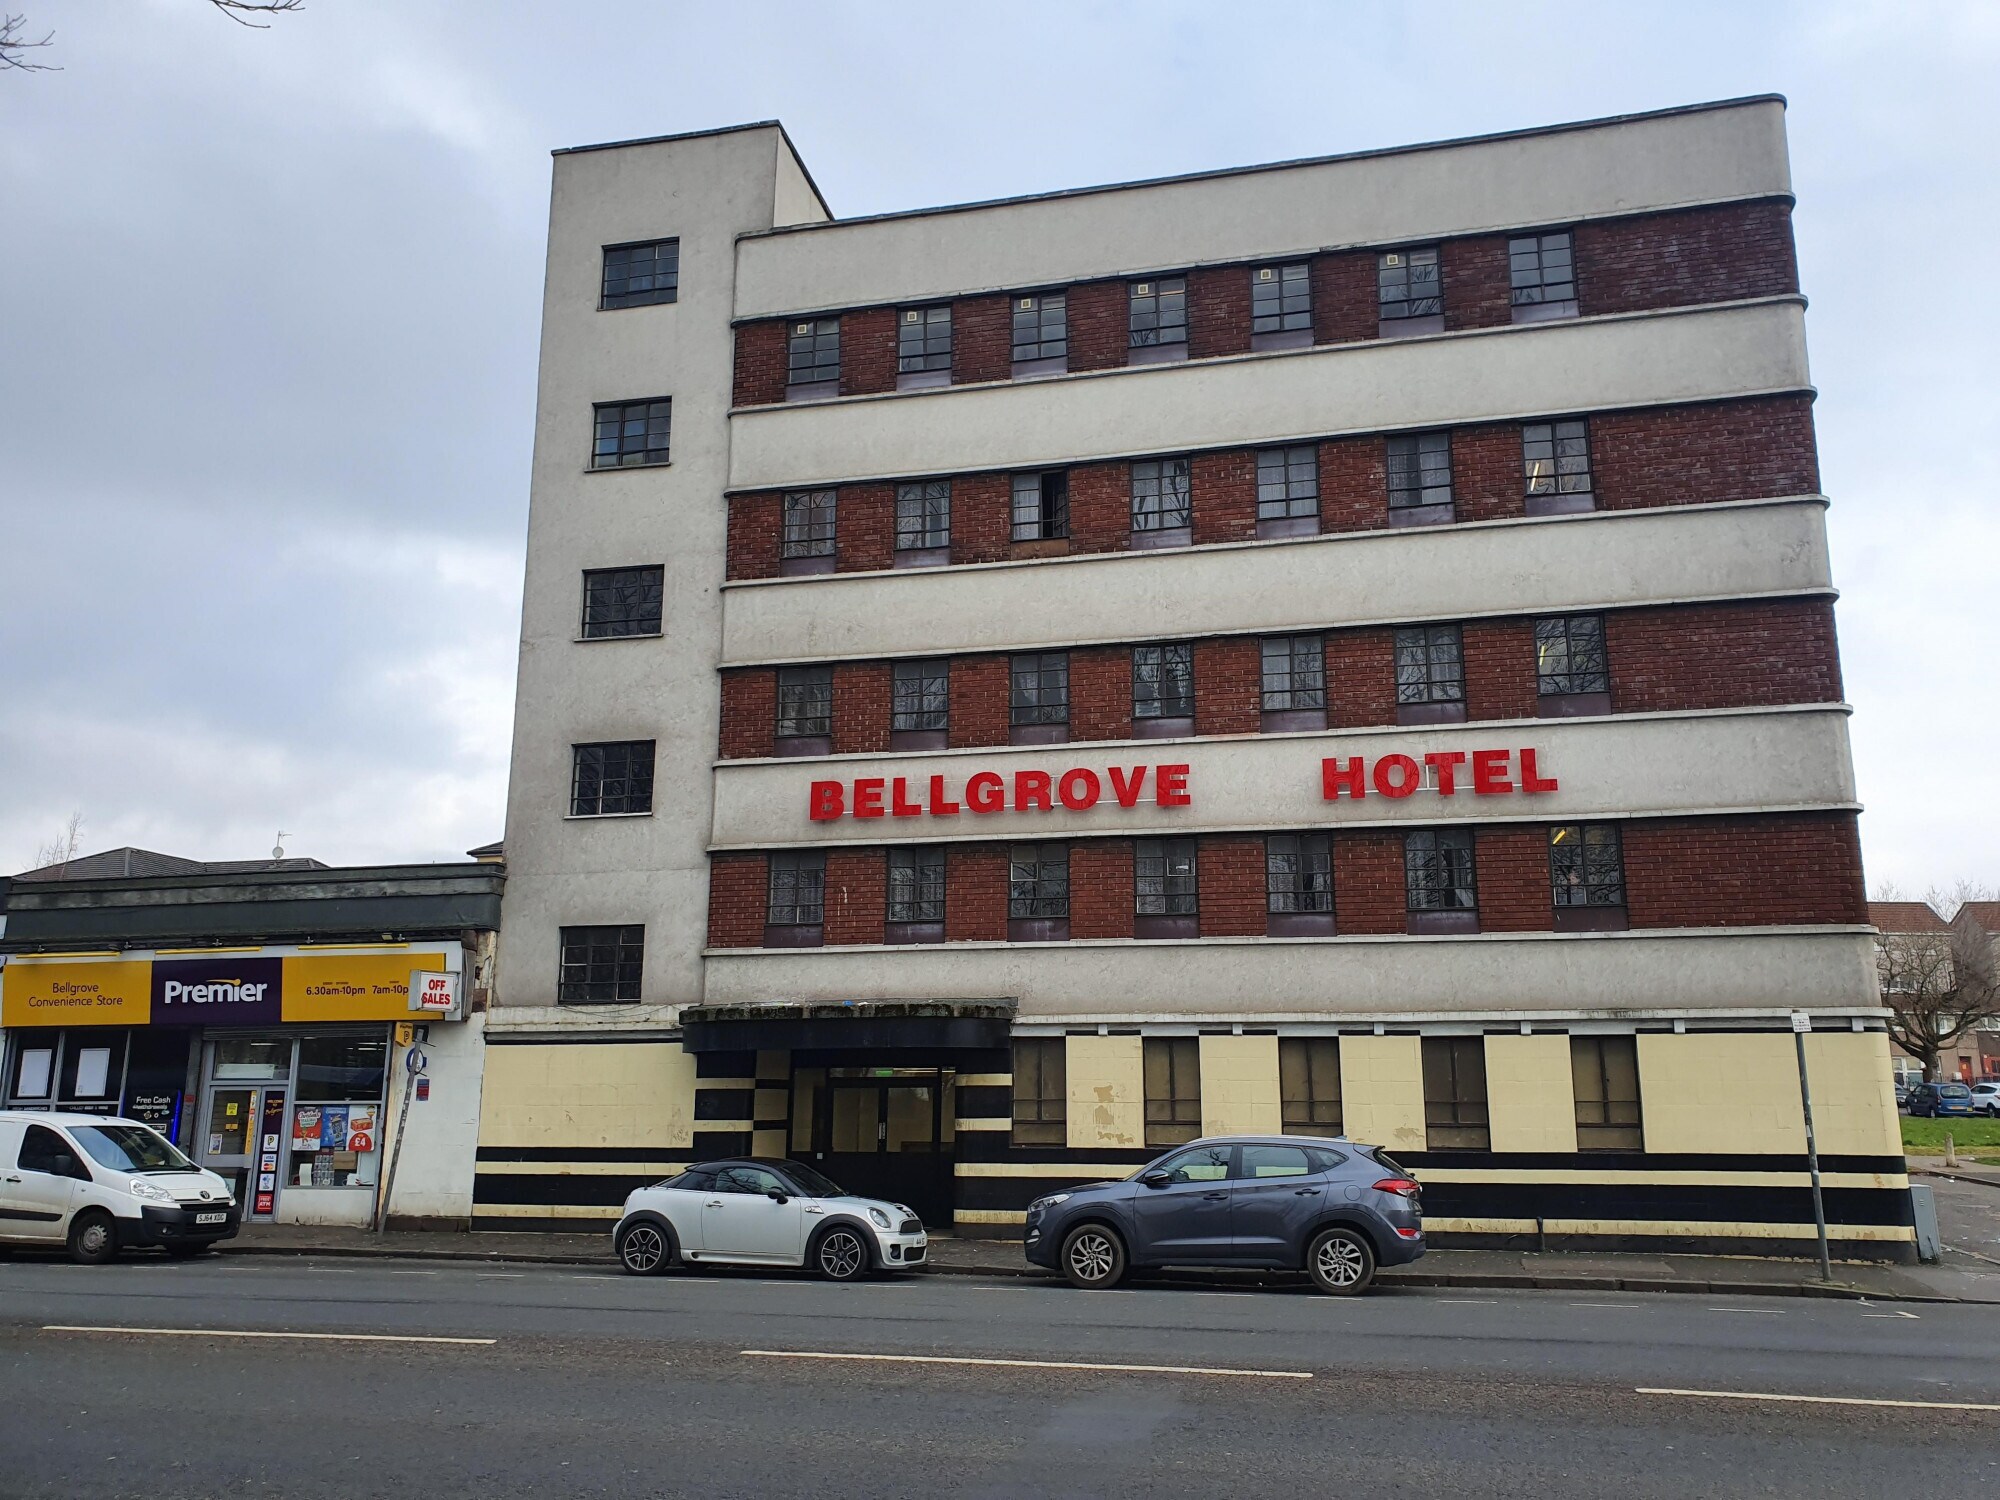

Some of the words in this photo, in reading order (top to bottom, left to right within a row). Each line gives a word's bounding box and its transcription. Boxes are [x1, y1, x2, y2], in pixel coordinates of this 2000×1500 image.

[809, 764, 1191, 821] BELLGROVE
[1321, 748, 1559, 801] HOTEL
[52, 982, 99, 996] Bellgrove
[306, 985, 366, 996] 6.30am-10pm
[372, 984, 409, 996] 7am-10p
[428, 978, 446, 990] OFF
[164, 979, 268, 1004] Premier
[28, 995, 93, 1007] Convenience
[96, 995, 123, 1006] Store
[422, 992, 451, 1005] SALES
[136, 1096, 152, 1104] Free
[153, 1096, 171, 1104] Cash
[354, 1136, 366, 1147] £4
